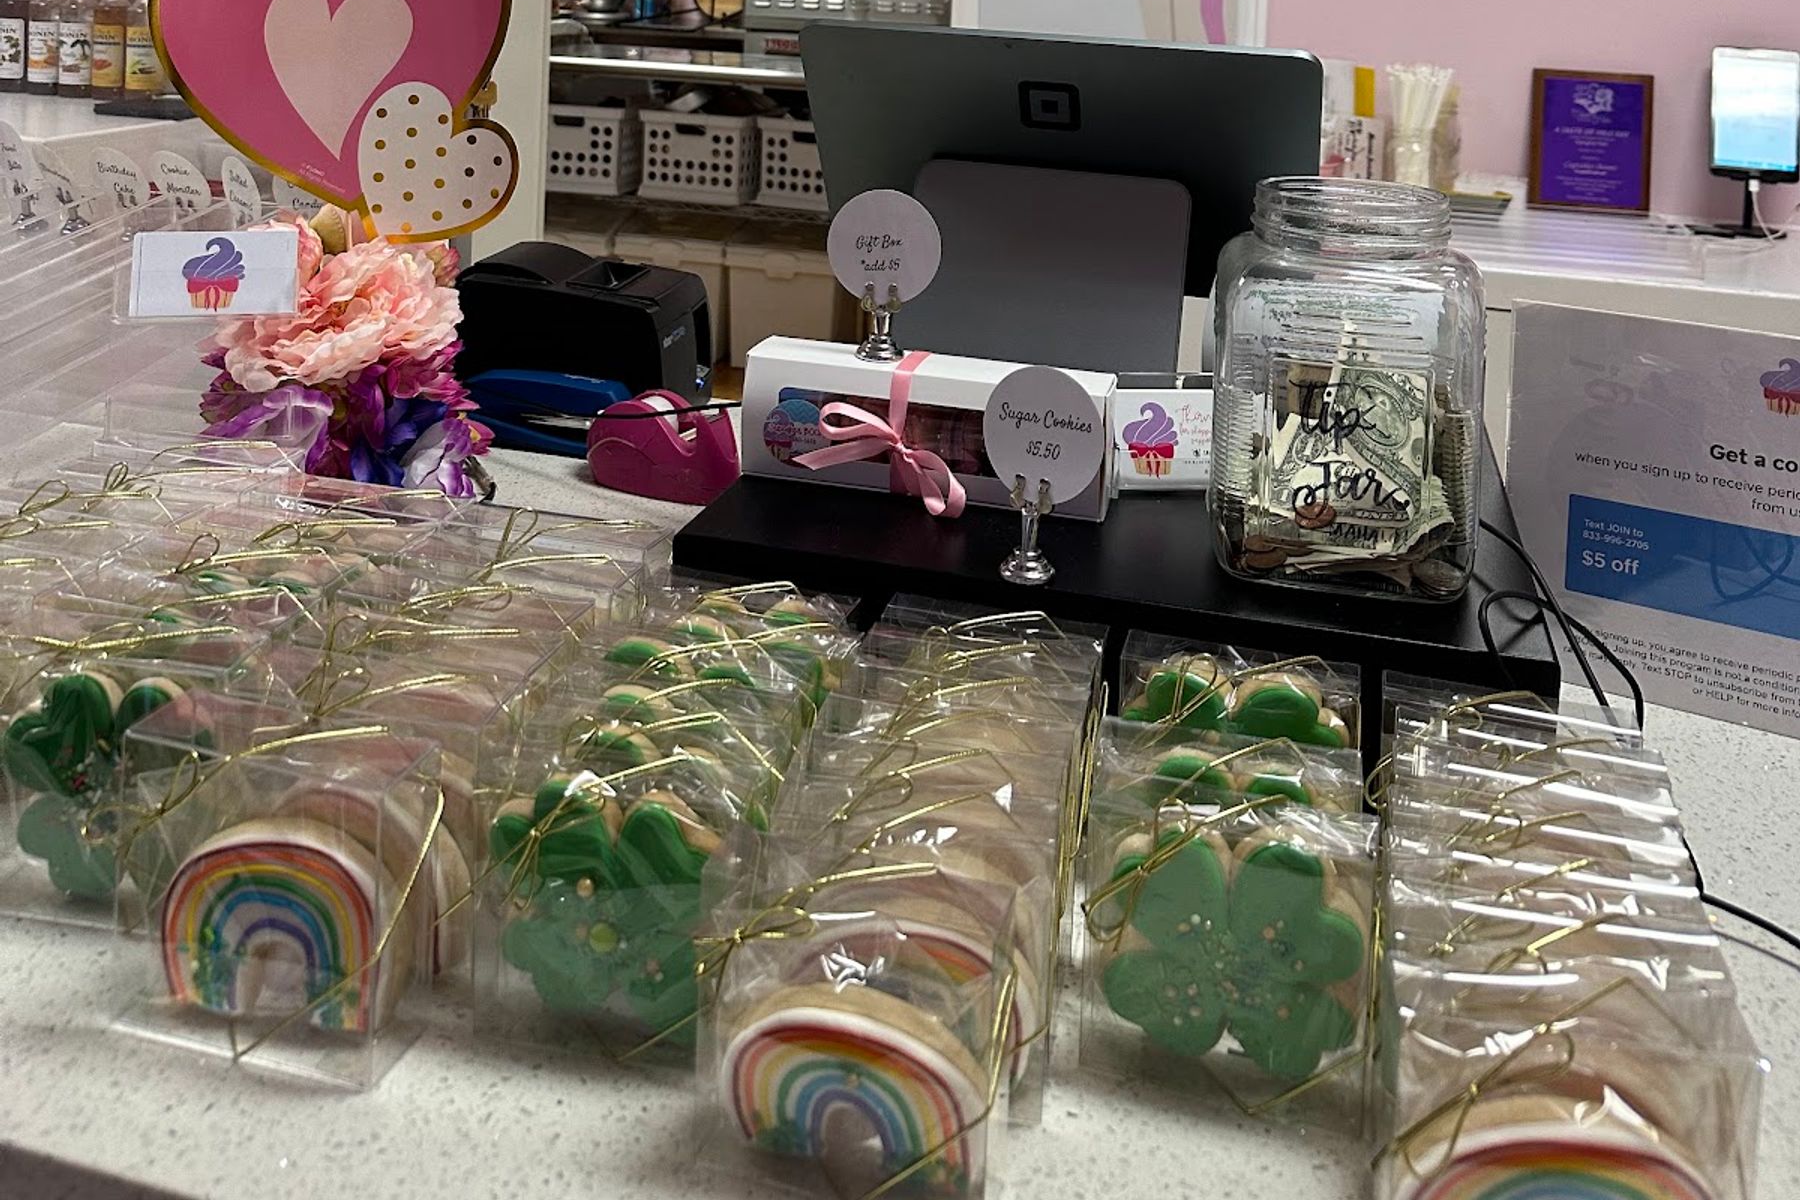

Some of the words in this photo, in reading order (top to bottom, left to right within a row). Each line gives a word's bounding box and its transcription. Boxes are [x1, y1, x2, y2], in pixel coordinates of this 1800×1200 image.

[856, 234, 880, 253] Gift
[881, 234, 904, 249] Box
[999, 402, 1041, 429] Sugar
[1043, 409, 1092, 433] Cookies
[1288, 379, 1378, 455] Tip
[1026, 441, 1061, 460] $5.50
[1710, 444, 1748, 464] Get
[1754, 455, 1766, 468] a
[1575, 452, 1610, 466] when
[1613, 459, 1638, 471] you
[1641, 463, 1669, 478] sign
[1673, 470, 1691, 482] up
[1695, 471, 1708, 484] to
[1713, 476, 1763, 494] receive
[1292, 459, 1411, 520] Jar
[1752, 497, 1785, 515] from
[1584, 519, 1605, 531] Text
[1607, 523, 1631, 535] JOIN
[1632, 528, 1644, 538] to
[1582, 550, 1606, 568] $5
[1611, 558, 1640, 575] off
[1595, 629, 1629, 645] signing
[1648, 641, 1667, 652] you
[1668, 647, 1697, 659] agree
[1700, 652, 1710, 662] to
[1713, 656, 1749, 670] receive
[1752, 665, 1793, 681] periodic
[1613, 644, 1647, 660] Joining
[1650, 652, 1667, 664] this
[1669, 658, 1711, 674] program
[1714, 667, 1722, 676] is
[1725, 671, 1742, 681] not
[1641, 661, 1662, 675] Text
[1664, 668, 1692, 680] STOP
[1694, 675, 1704, 684] to
[1706, 678, 1768, 698] unsubscribe
[1771, 692, 1796, 705] from
[1692, 687, 1703, 695] or
[1705, 689, 1734, 702] HELP
[1737, 696, 1750, 706] for
[1753, 701, 1780, 714] more
